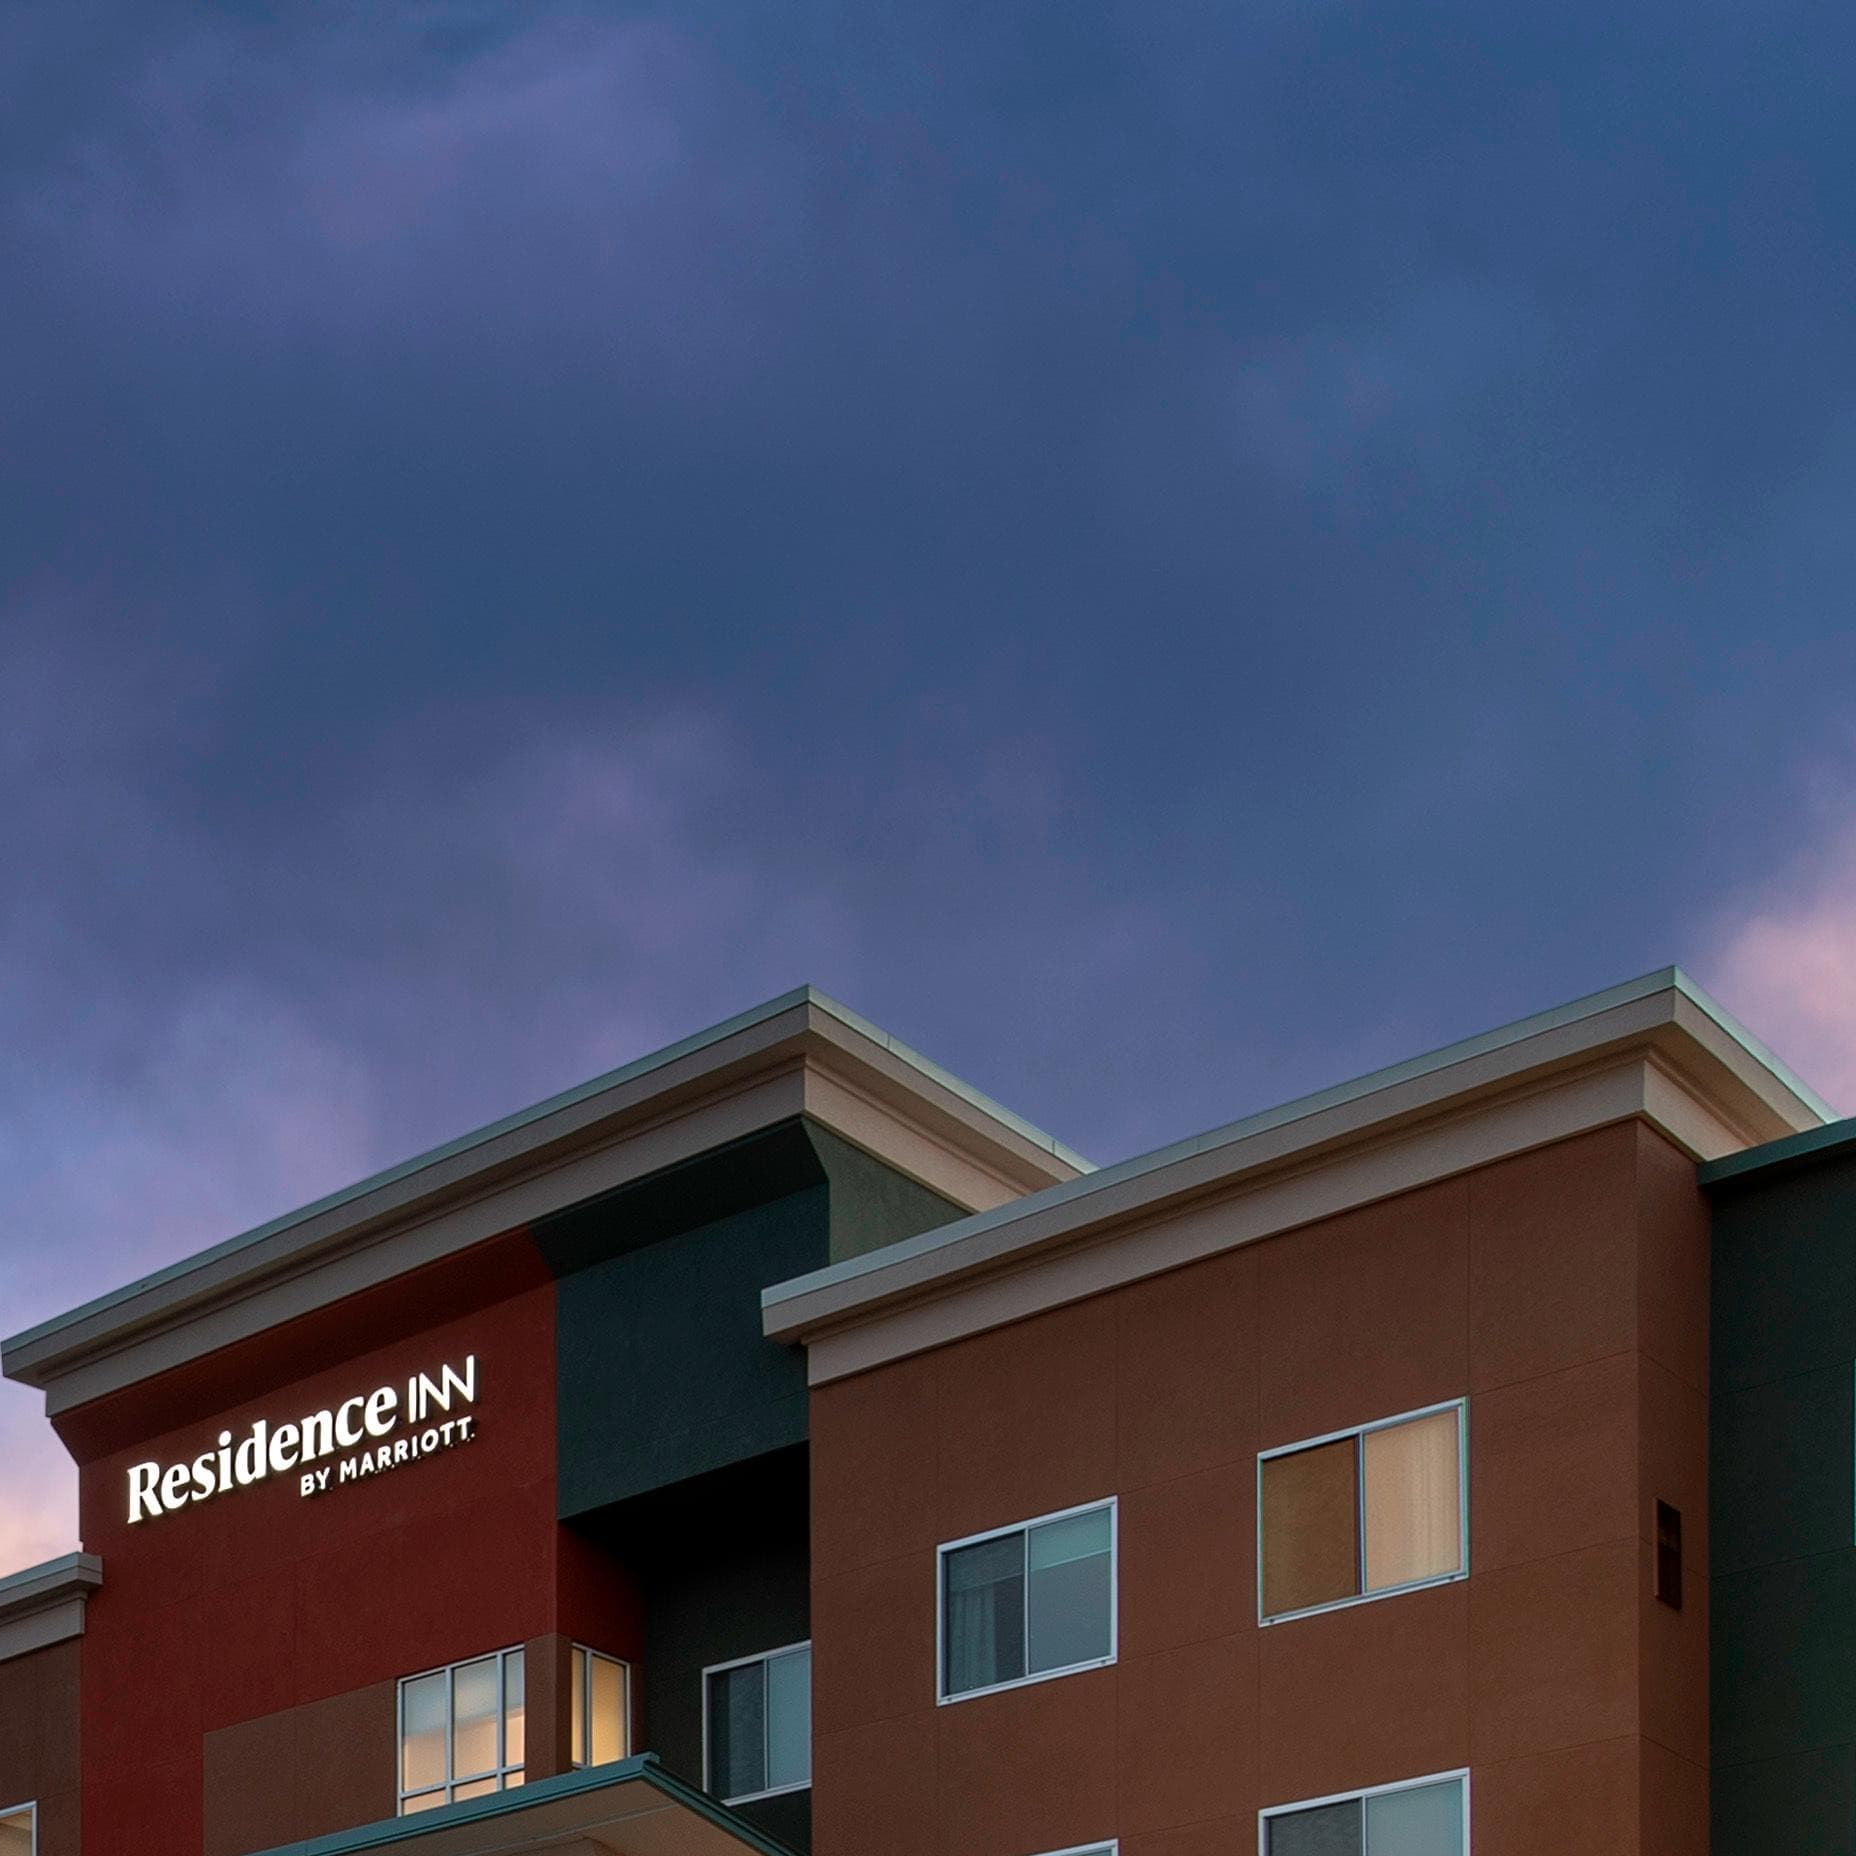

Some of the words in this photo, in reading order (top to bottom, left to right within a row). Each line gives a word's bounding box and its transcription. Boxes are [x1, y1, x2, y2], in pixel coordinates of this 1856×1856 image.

[126, 1386, 399, 1522] Residence
[408, 1354, 476, 1424] INN
[300, 1466, 331, 1498] BY
[339, 1415, 474, 1483] MARRIOTT
